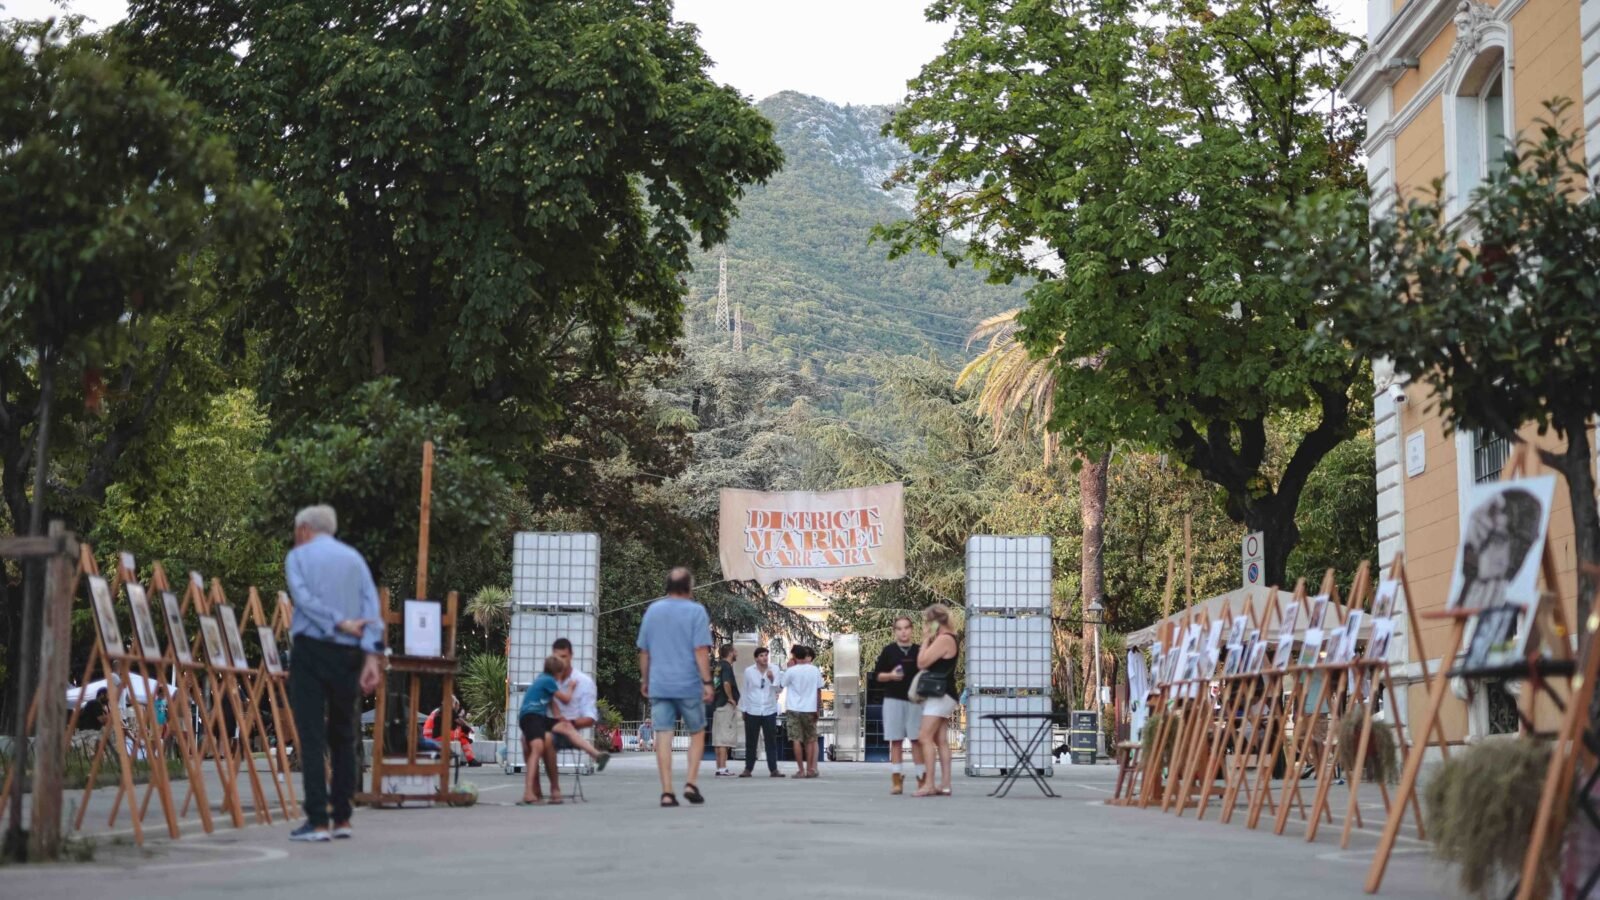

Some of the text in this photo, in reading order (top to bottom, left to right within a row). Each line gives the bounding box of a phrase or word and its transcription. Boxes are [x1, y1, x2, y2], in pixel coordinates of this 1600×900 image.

[748, 507, 880, 530] DISTRICT
[746, 525, 882, 552] MARKET
[755, 547, 873, 567] CARRARA
